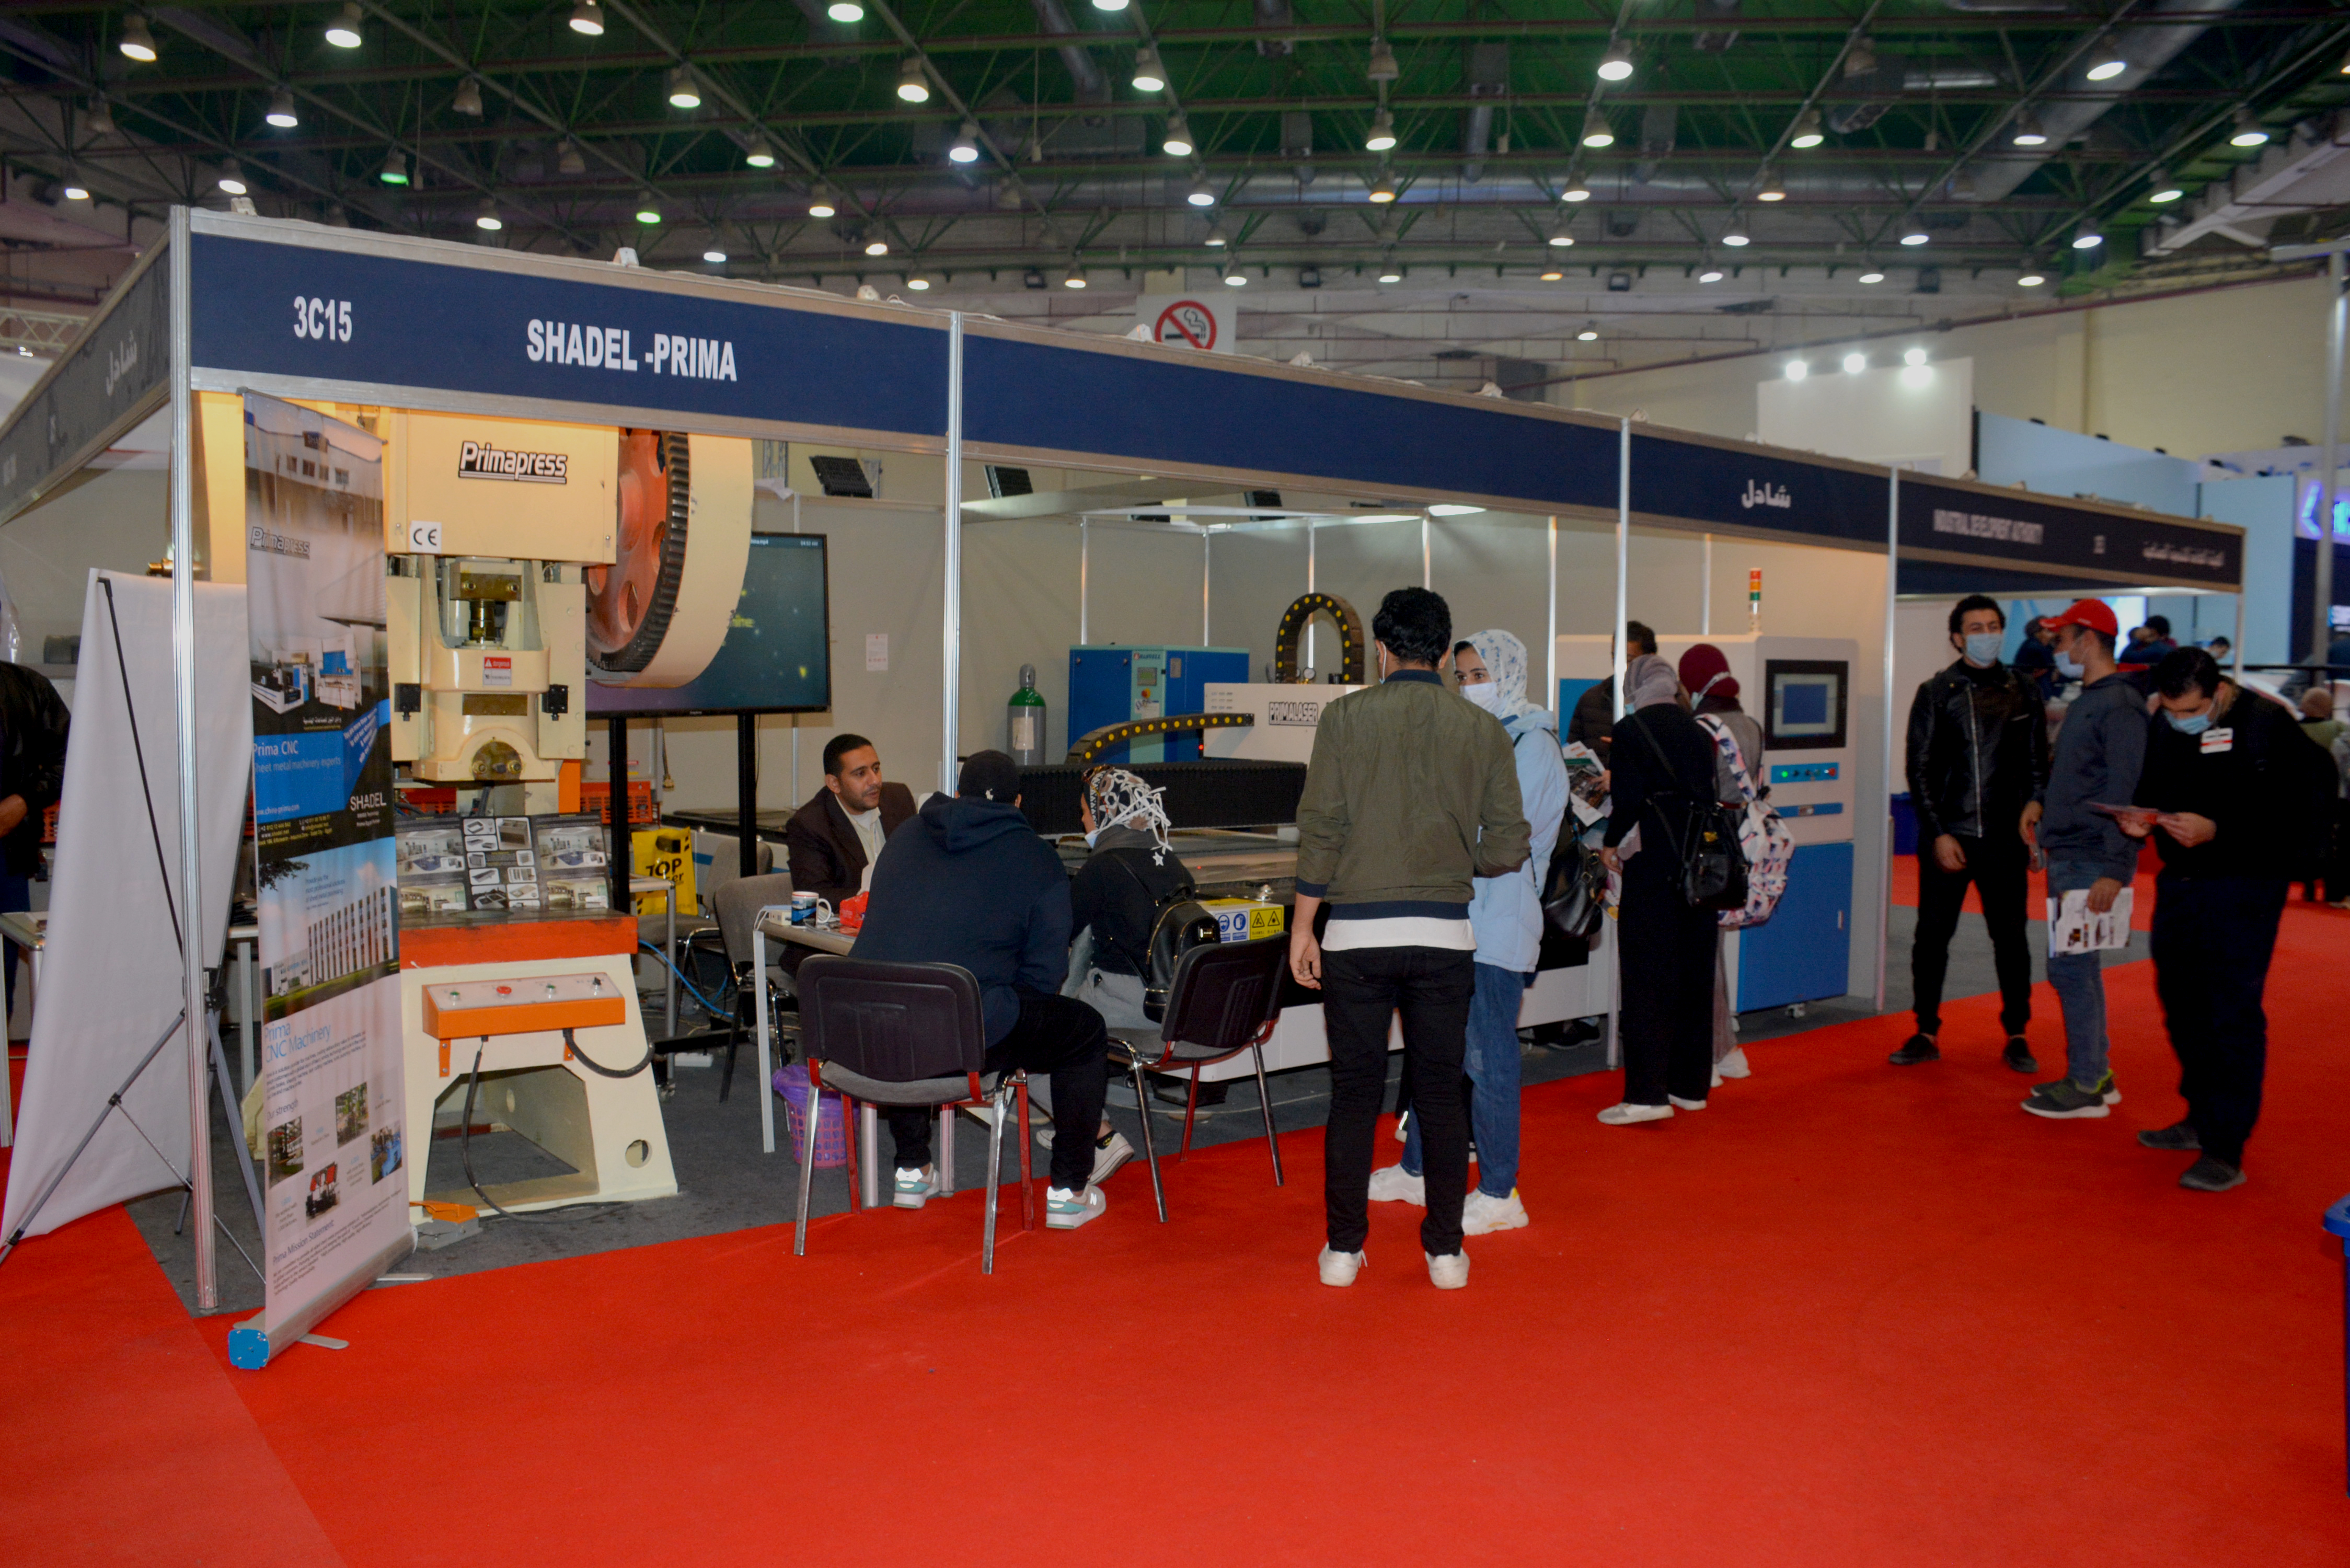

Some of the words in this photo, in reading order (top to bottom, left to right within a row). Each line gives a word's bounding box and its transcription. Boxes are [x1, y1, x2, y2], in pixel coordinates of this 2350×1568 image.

[293, 296, 352, 342] 3C15
[527, 319, 638, 372] SHADEL
[460, 441, 567, 481] Primapress
[1742, 479, 1791, 509] شادل
[251, 526, 310, 557] Primapress
[1269, 701, 1318, 725] PRIMALASER
[254, 742, 279, 756] Prima
[281, 740, 298, 755] CNC
[350, 792, 387, 812] SHADEL
[646, 858, 682, 877] TOP
[264, 1023, 291, 1044] Prima
[266, 1040, 287, 1063] CNC
[289, 1024, 331, 1053] Machinery
[276, 1099, 298, 1116] strength
[1090, 1193, 1097, 1206] N
[272, 1251, 287, 1265] Prima
[287, 1236, 308, 1256] Mission
